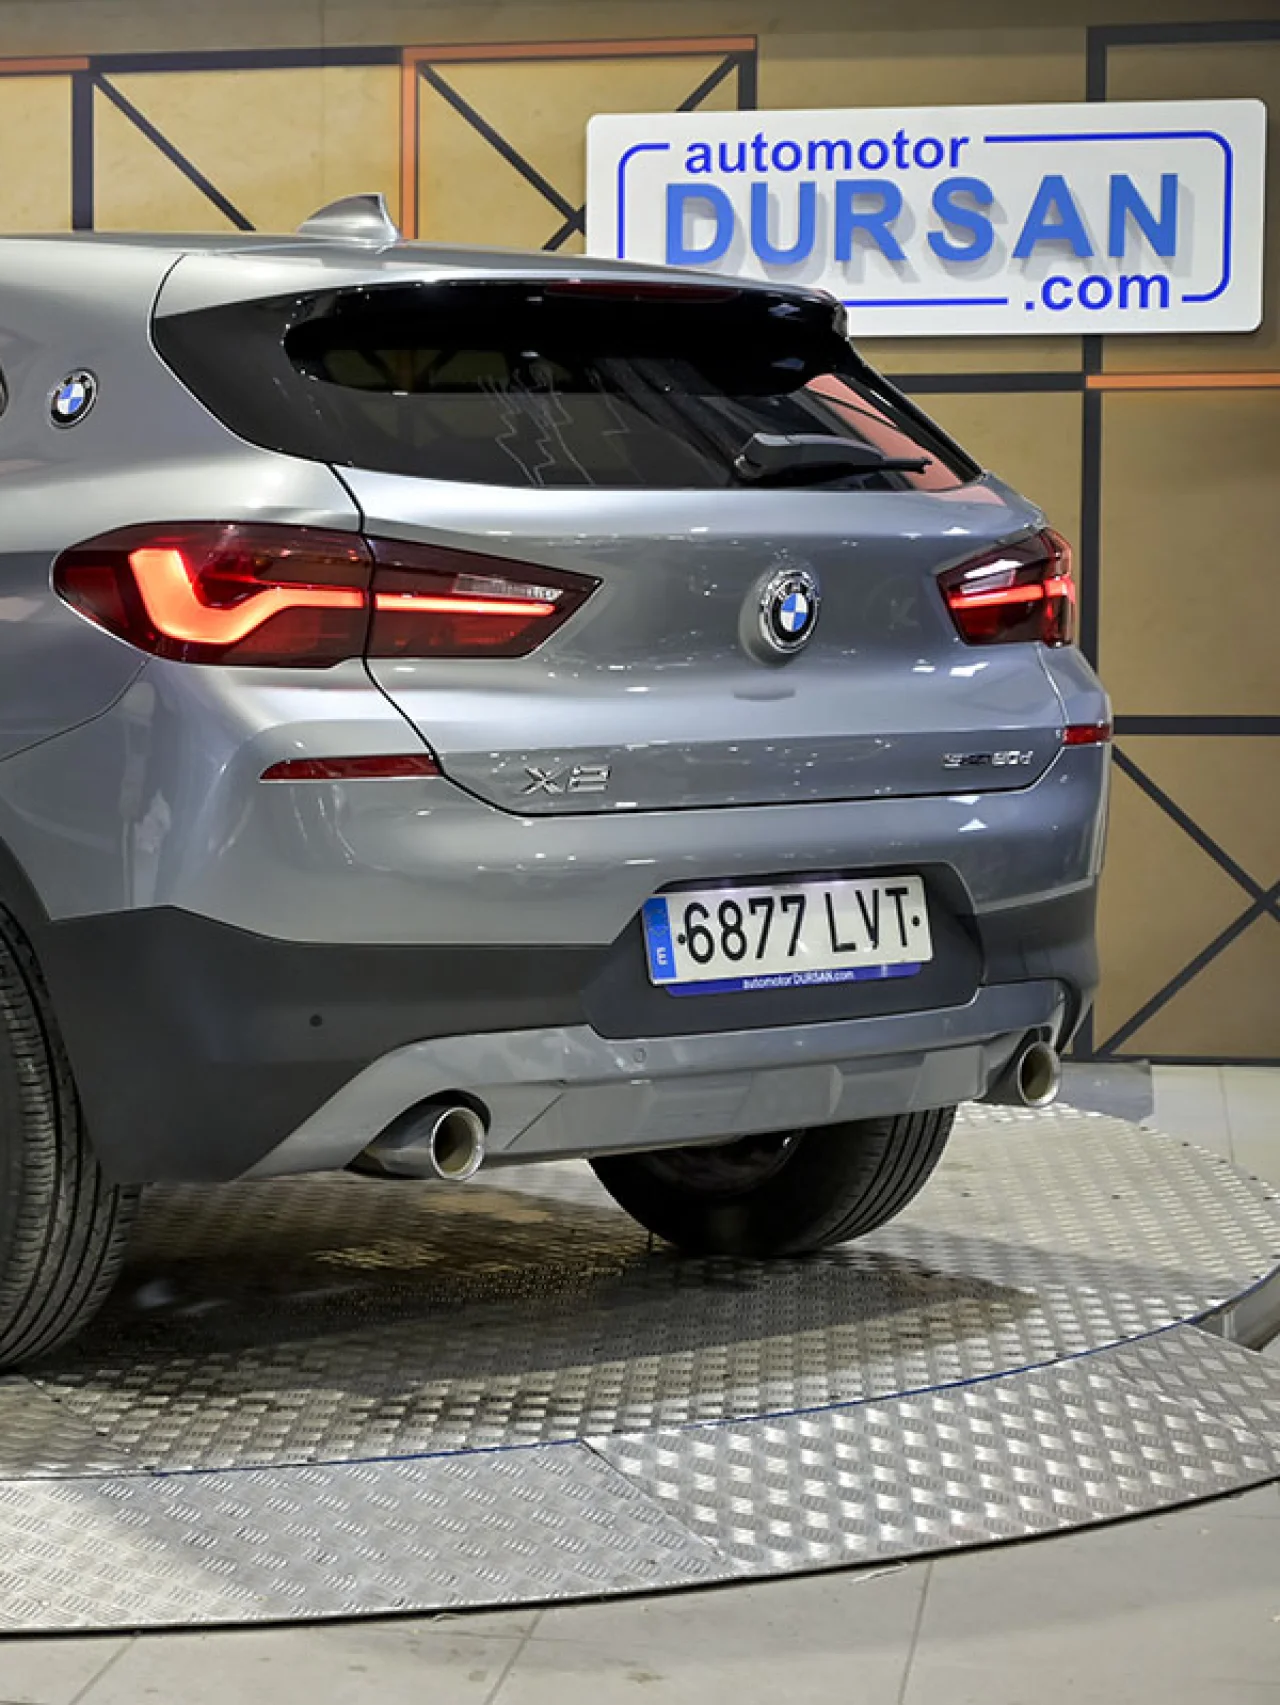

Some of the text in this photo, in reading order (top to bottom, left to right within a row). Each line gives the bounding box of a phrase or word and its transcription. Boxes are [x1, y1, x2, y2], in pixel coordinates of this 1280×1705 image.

[684, 129, 970, 174] automotor
[665, 172, 1179, 266] DURSAN
[1024, 271, 1171, 311] .com
[521, 764, 612, 795] X2
[684, 887, 909, 965] 6877 LVT
[656, 946, 669, 966] E
